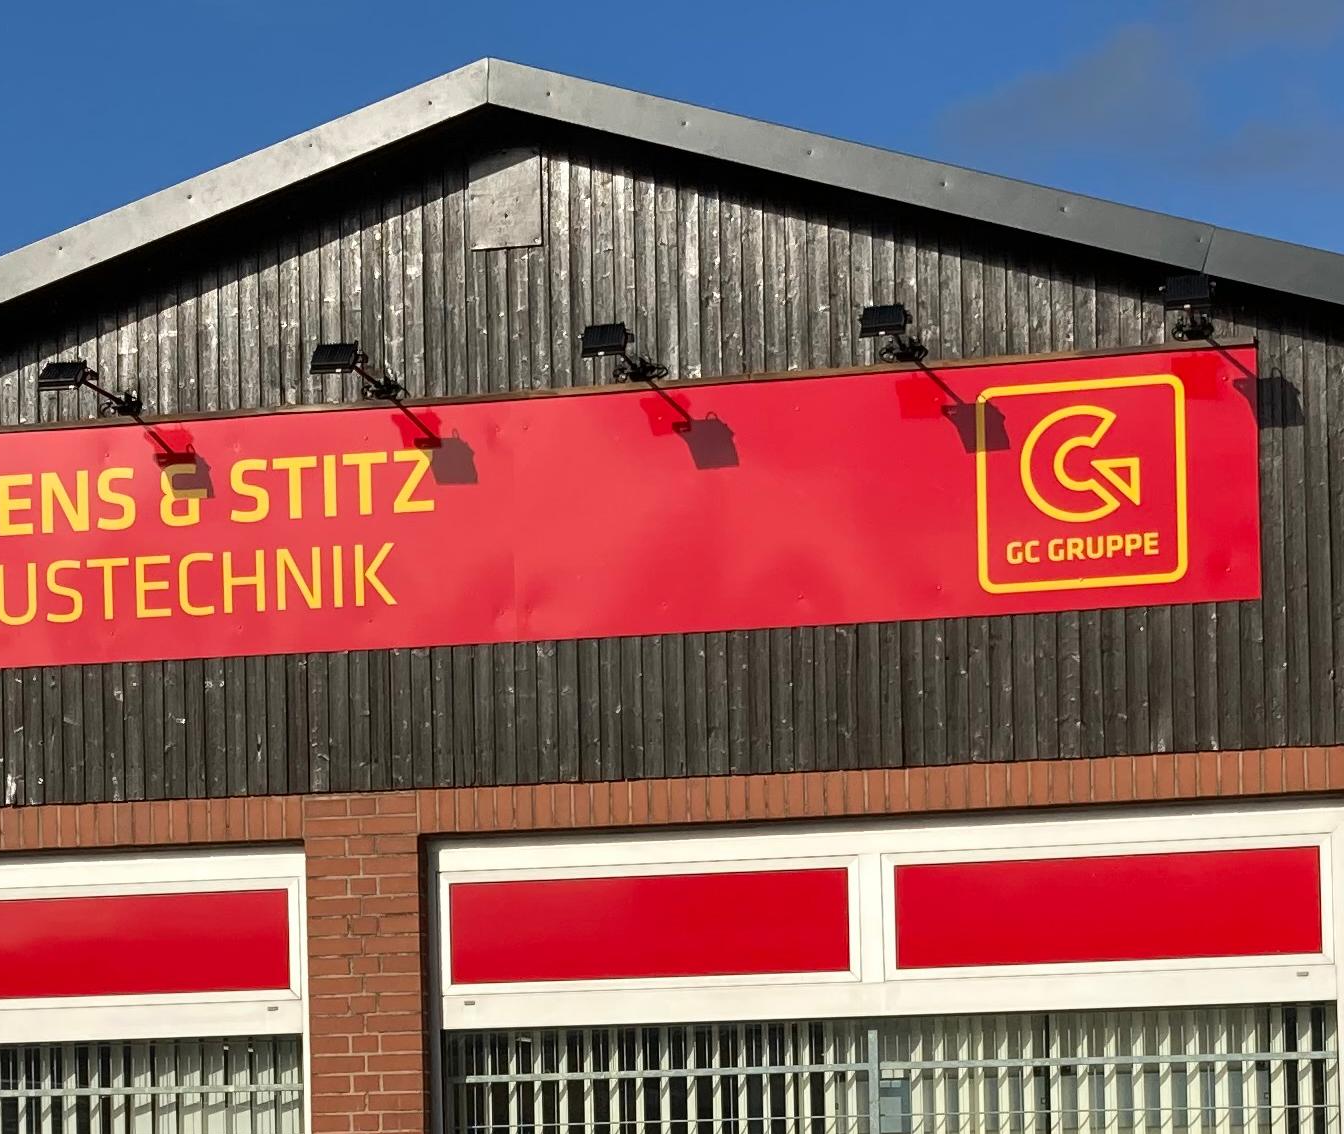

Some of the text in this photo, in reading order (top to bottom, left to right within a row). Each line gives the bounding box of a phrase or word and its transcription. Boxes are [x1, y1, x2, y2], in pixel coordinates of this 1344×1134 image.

[159, 463, 209, 527] &
[229, 449, 437, 523] STITZ
[1005, 532, 1160, 565] GC GRUPPE
